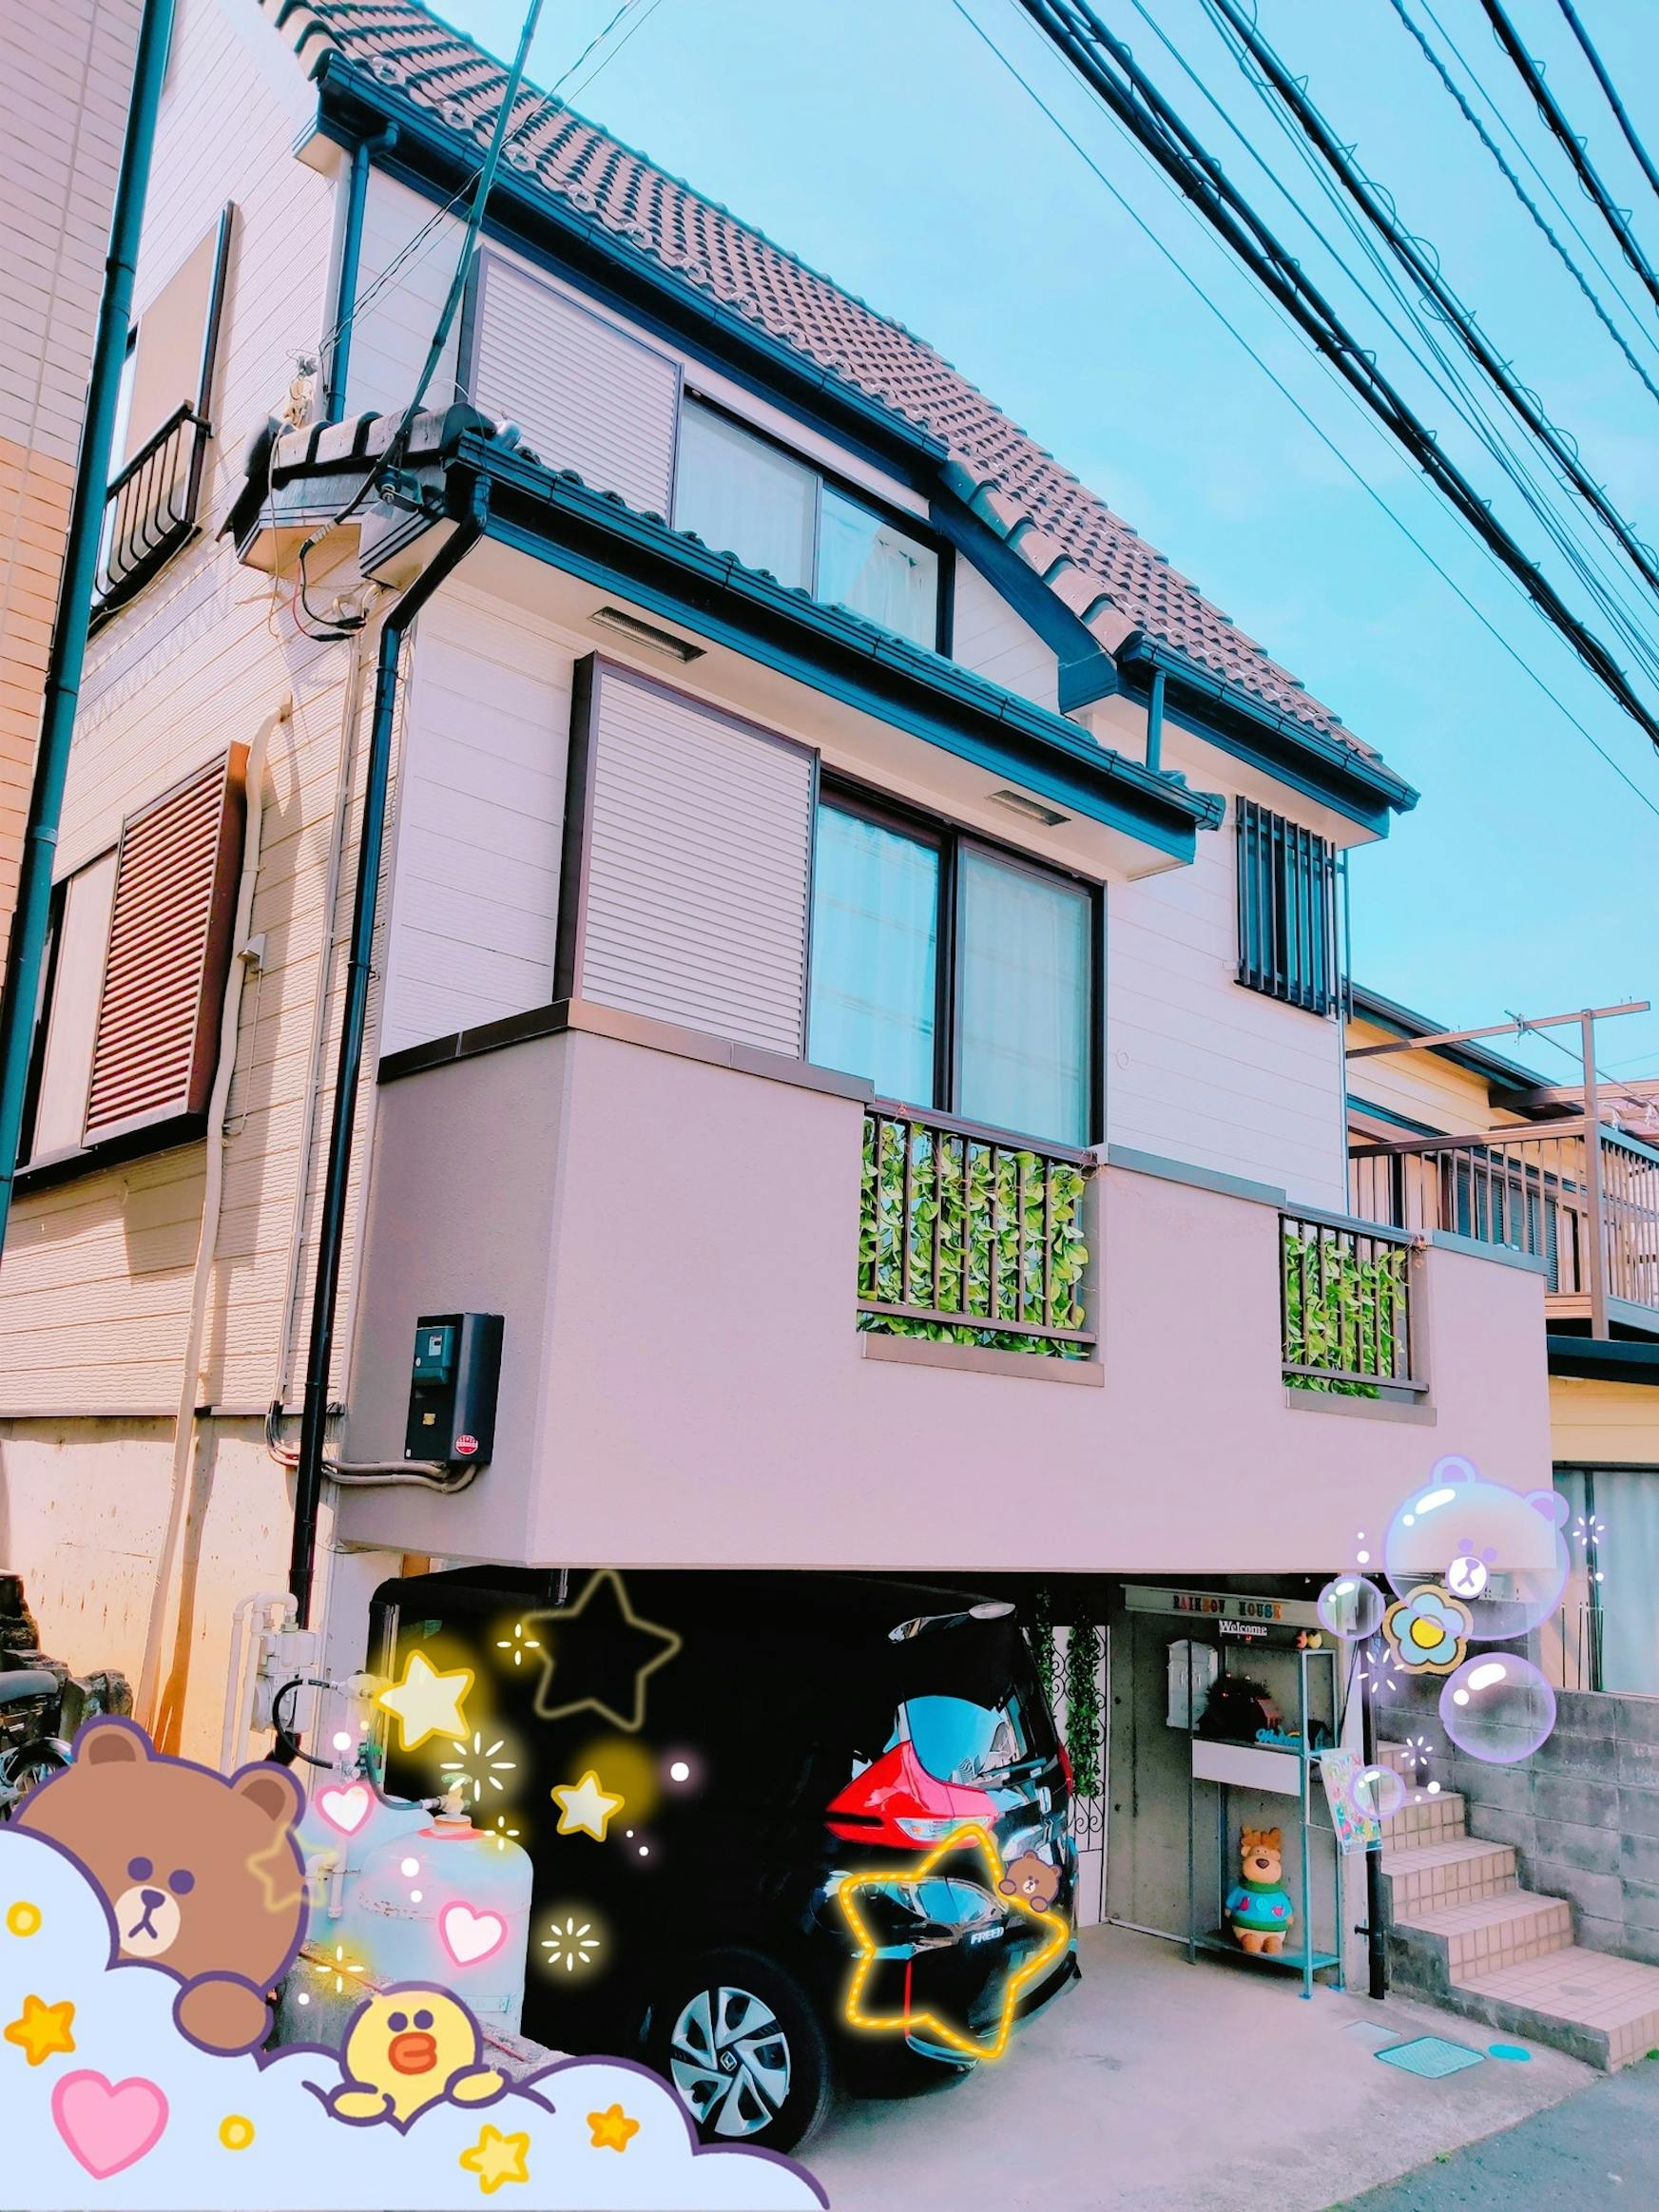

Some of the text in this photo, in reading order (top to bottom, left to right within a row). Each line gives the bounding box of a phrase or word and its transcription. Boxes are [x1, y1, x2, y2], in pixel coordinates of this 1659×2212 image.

[1239, 1602, 1282, 1620] HOUSE
[1219, 1619, 1267, 1636] Welcome
[971, 1926, 1004, 1945] FREED
